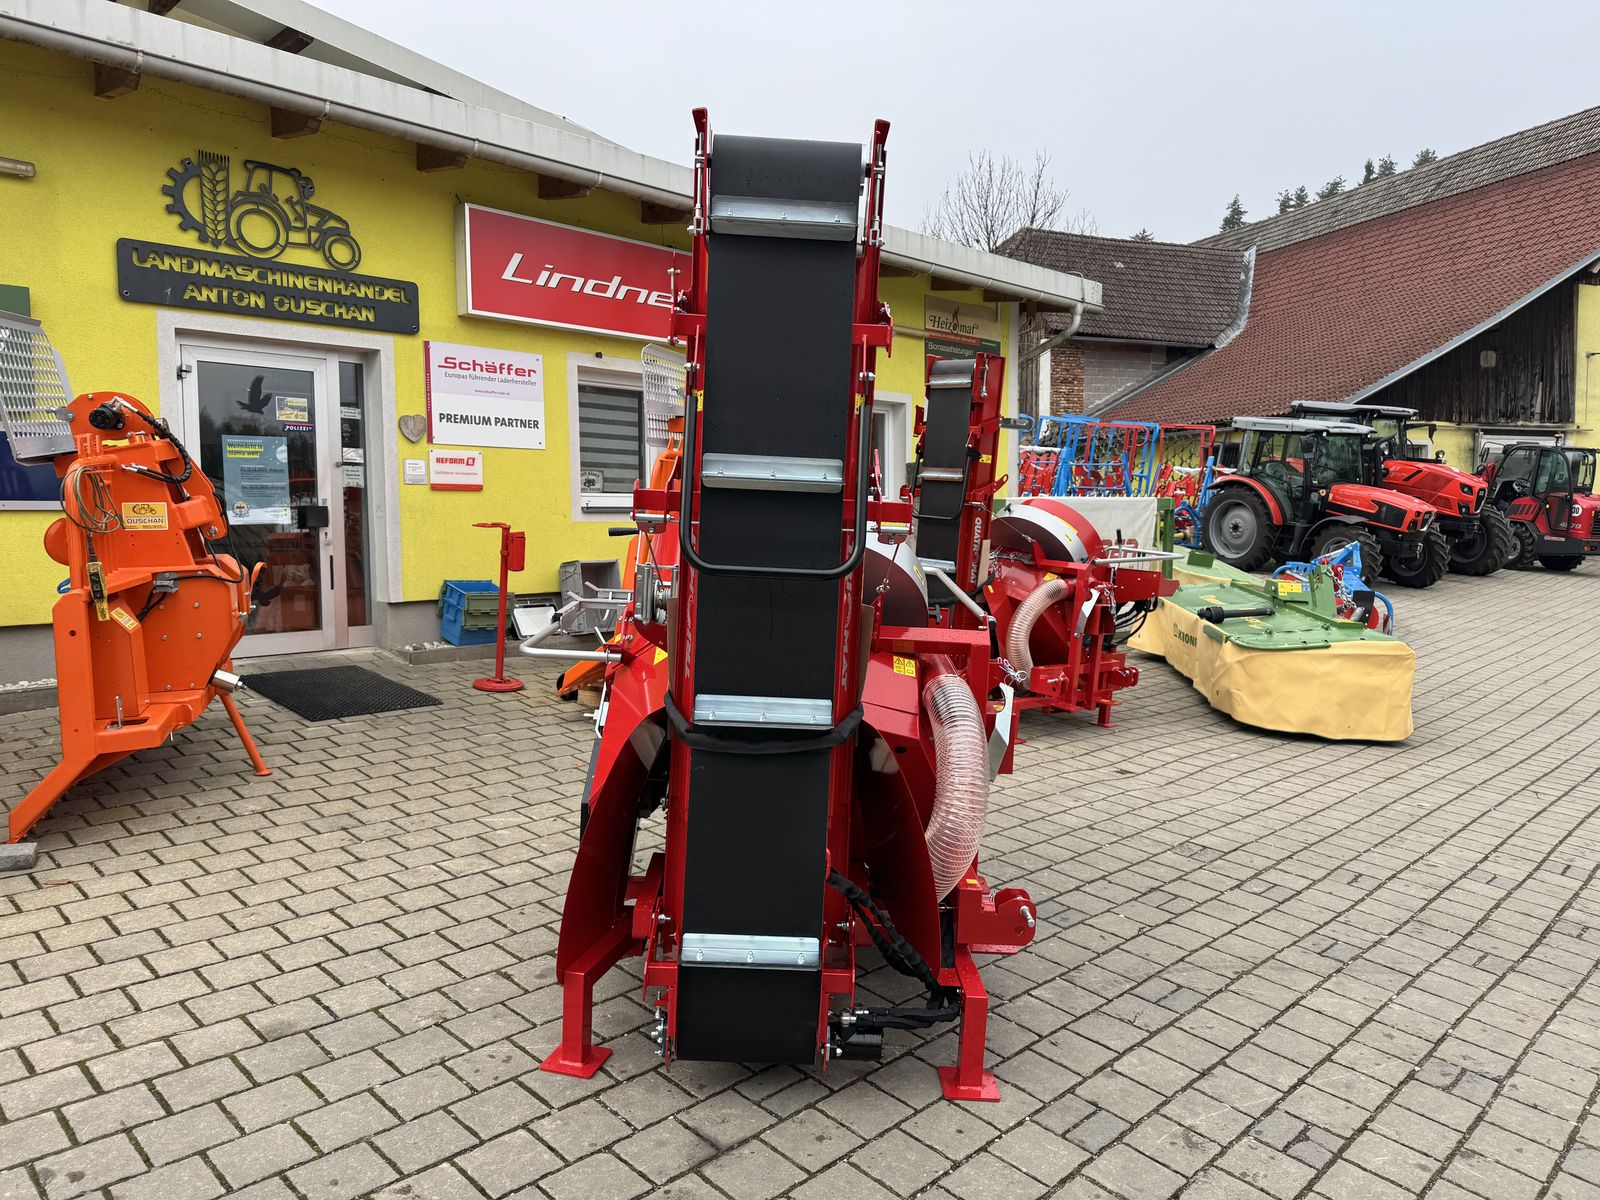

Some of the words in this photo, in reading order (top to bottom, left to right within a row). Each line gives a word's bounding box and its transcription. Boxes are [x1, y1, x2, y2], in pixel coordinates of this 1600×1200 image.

[131, 247, 412, 304] LANDMASCHINENHANDEL
[501, 252, 675, 310] Lindne
[183, 282, 266, 309] ANTON
[273, 294, 376, 323] OUSCHAN
[437, 356, 537, 378] Schäffer
[444, 371, 468, 380] Europas
[468, 374, 496, 382] führender
[497, 377, 537, 386] Laderhersteller
[439, 412, 492, 427] PREMIUM
[494, 417, 540, 429] PARTNER
